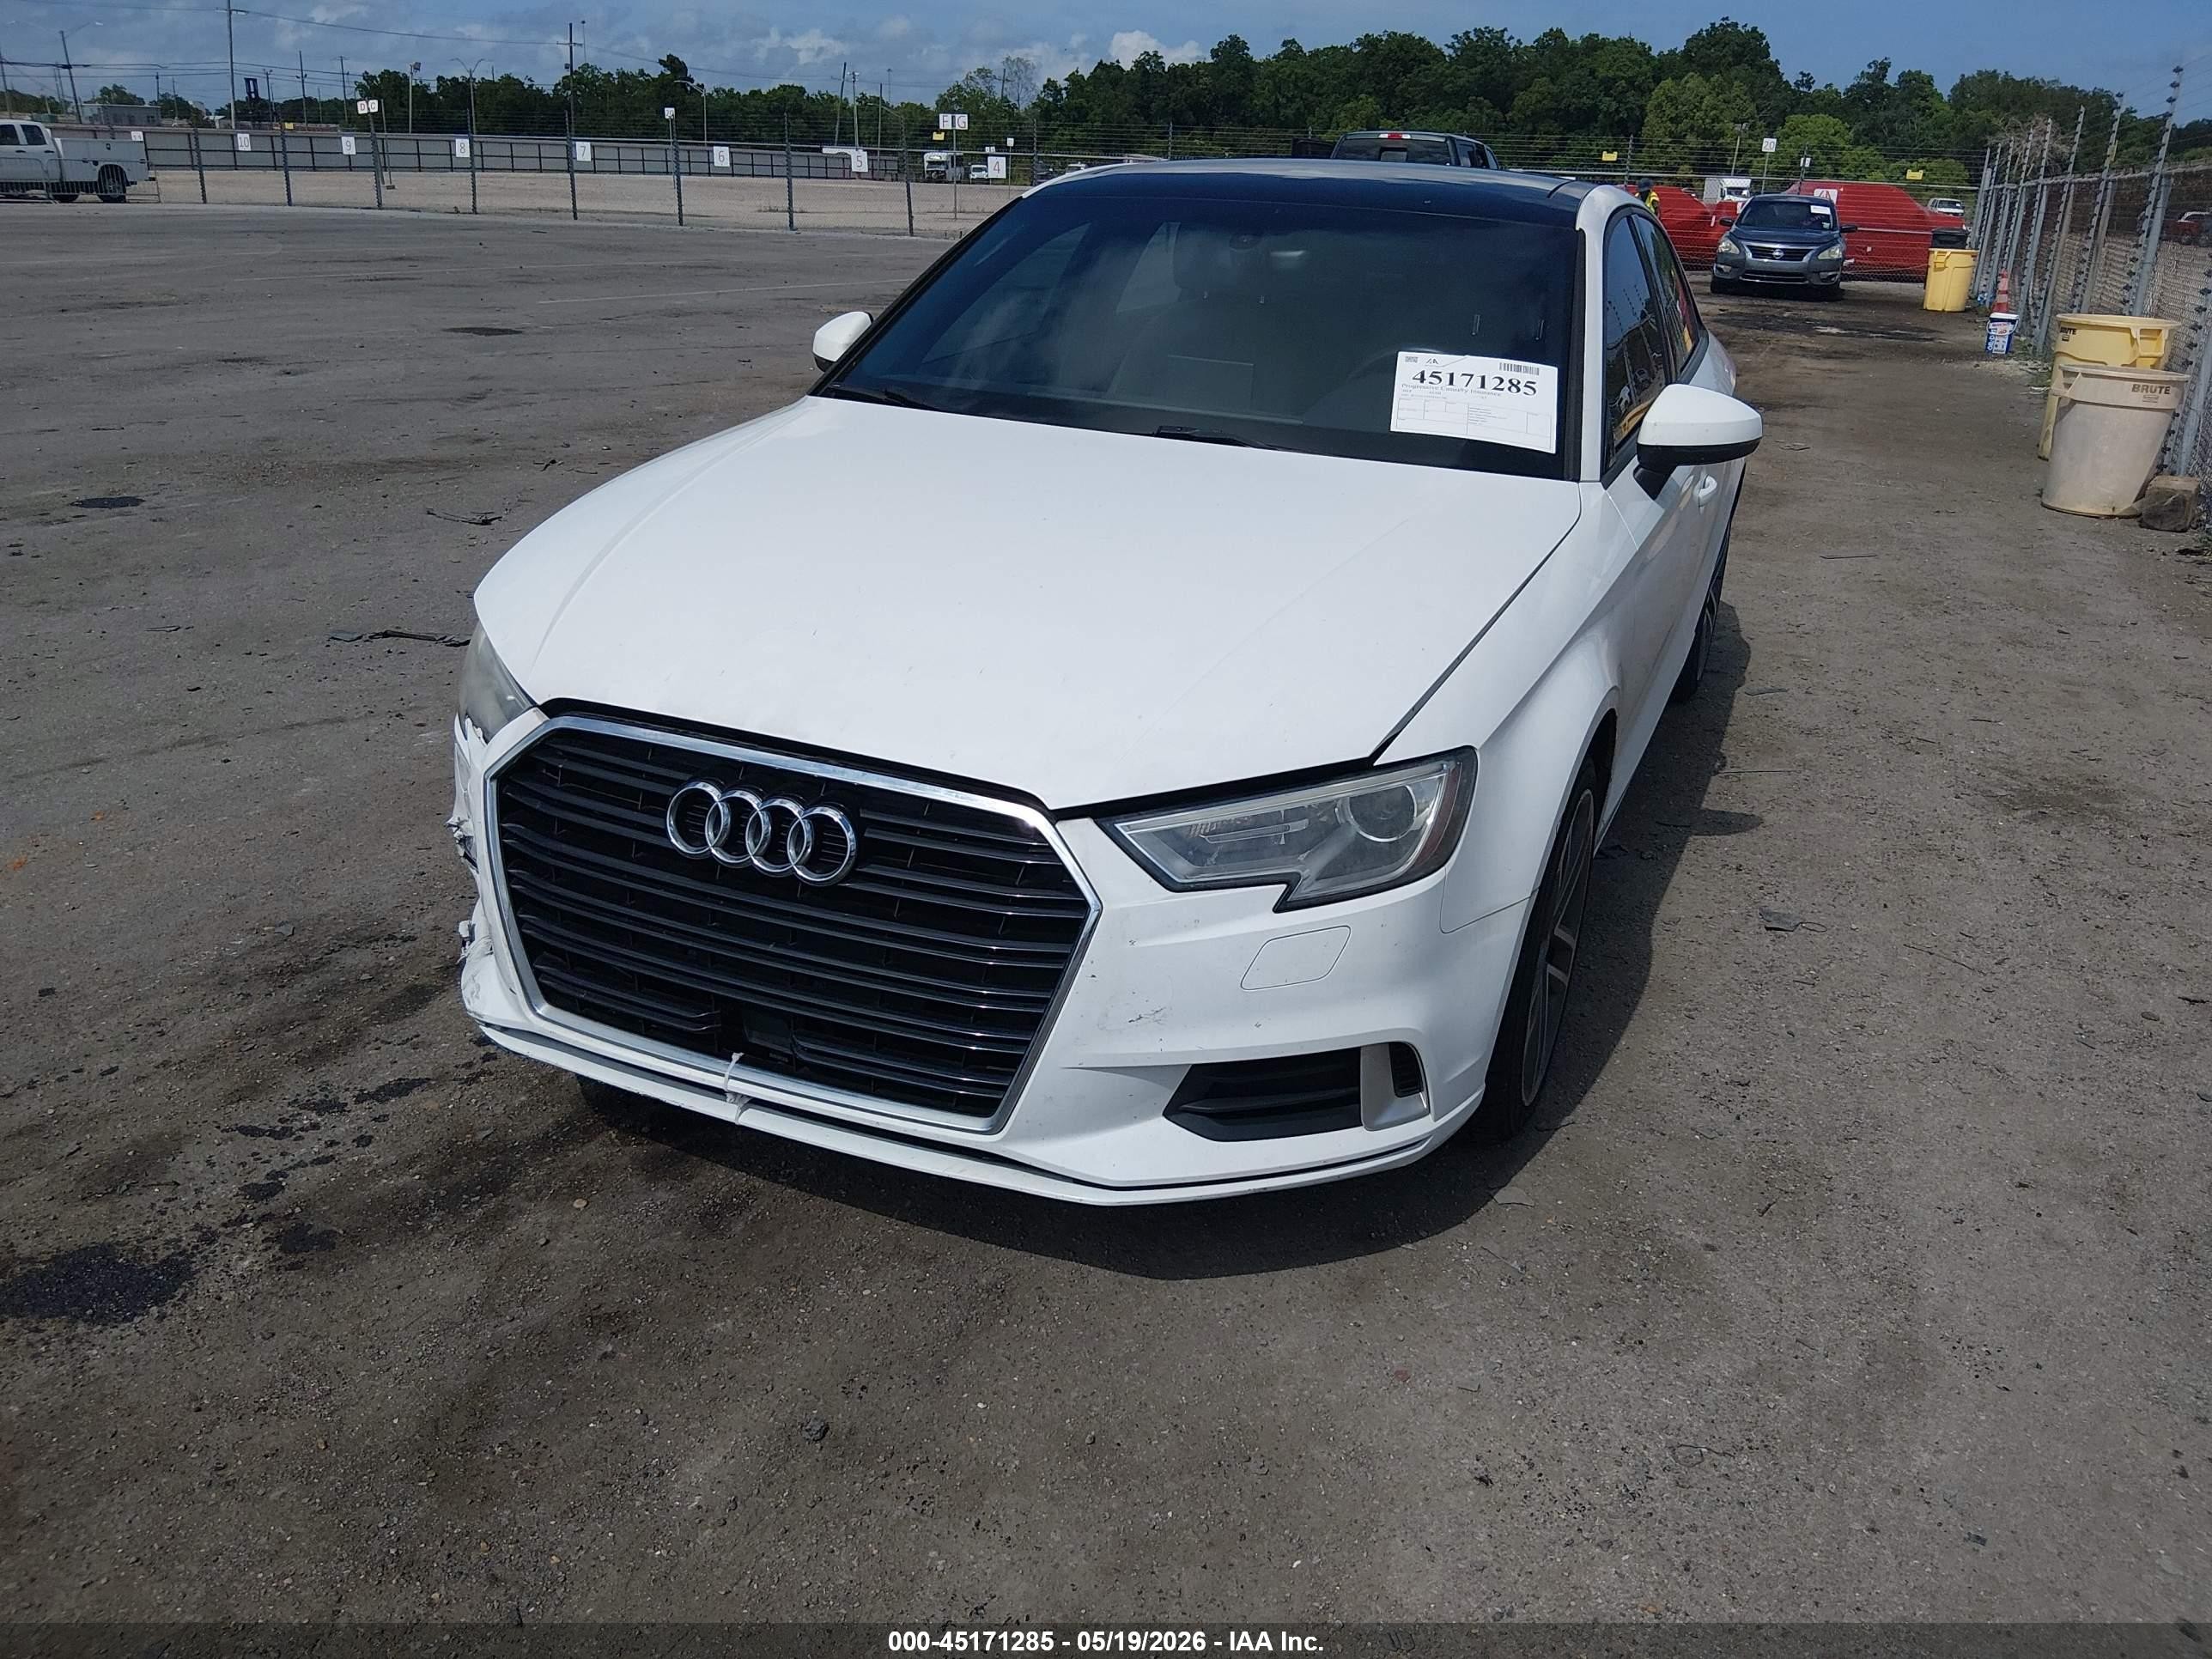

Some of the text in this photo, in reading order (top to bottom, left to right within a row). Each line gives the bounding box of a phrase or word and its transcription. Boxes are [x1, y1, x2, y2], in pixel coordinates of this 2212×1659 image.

[942, 115, 949, 128] F
[957, 115, 966, 129] G
[239, 137, 249, 148] 10
[345, 140, 352, 150] 9
[459, 142, 465, 154] 8
[1763, 140, 1775, 150] 20
[580, 145, 586, 158] 7
[718, 150, 725, 163] 6
[856, 155, 862, 167] 5
[993, 161, 1000, 174] 4
[1412, 369, 1537, 397] 45171285
[2131, 384, 2171, 395] BRUTE
